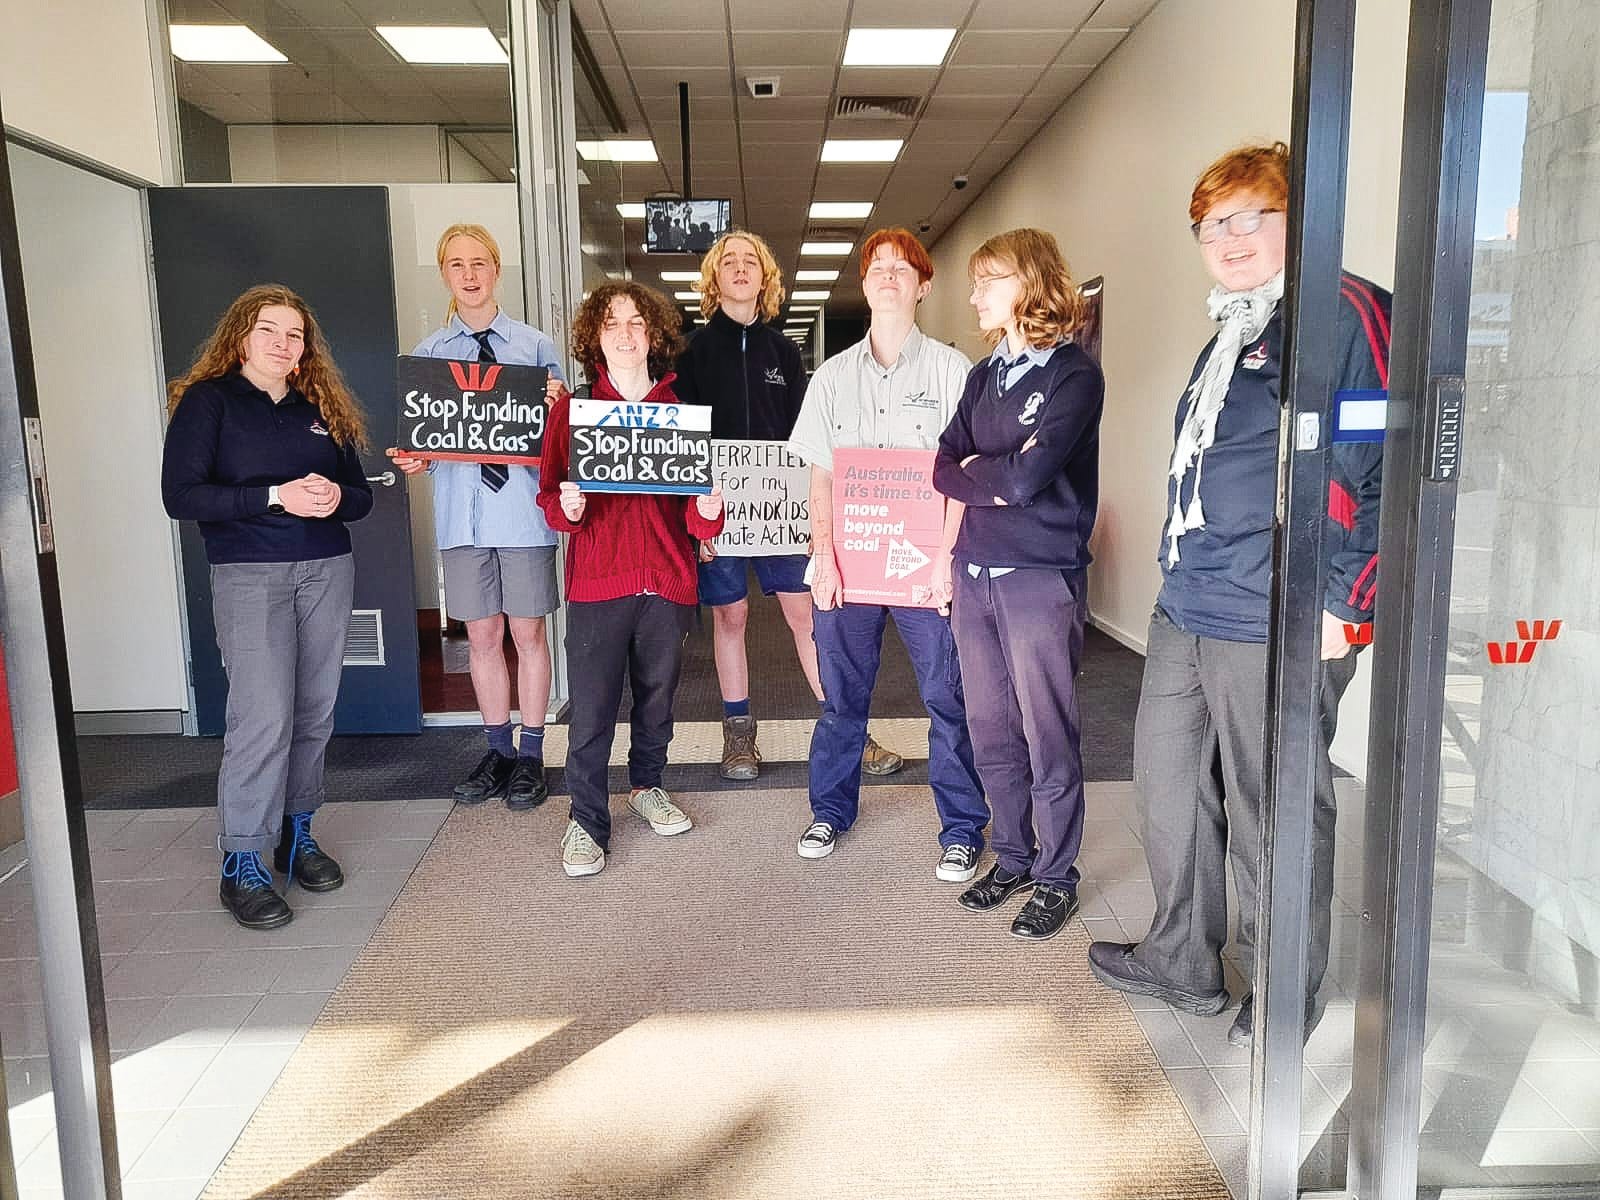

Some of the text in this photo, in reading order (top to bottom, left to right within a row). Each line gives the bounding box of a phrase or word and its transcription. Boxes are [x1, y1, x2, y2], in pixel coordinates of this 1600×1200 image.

[404, 390, 544, 439] Stop Funding
[596, 405, 661, 430] ANZ
[411, 421, 529, 451] Coal & Gas
[573, 428, 710, 466] Stop Funding
[578, 454, 709, 483] Coal & Gas
[844, 465, 927, 485] Australia,
[719, 471, 788, 502] for my
[844, 482, 933, 500] it's time to
[726, 499, 809, 521] RANDKIDS
[843, 503, 889, 517] move
[714, 521, 755, 546] mate
[761, 523, 785, 546] Act
[843, 518, 905, 538] beyond
[843, 537, 880, 552] coal
